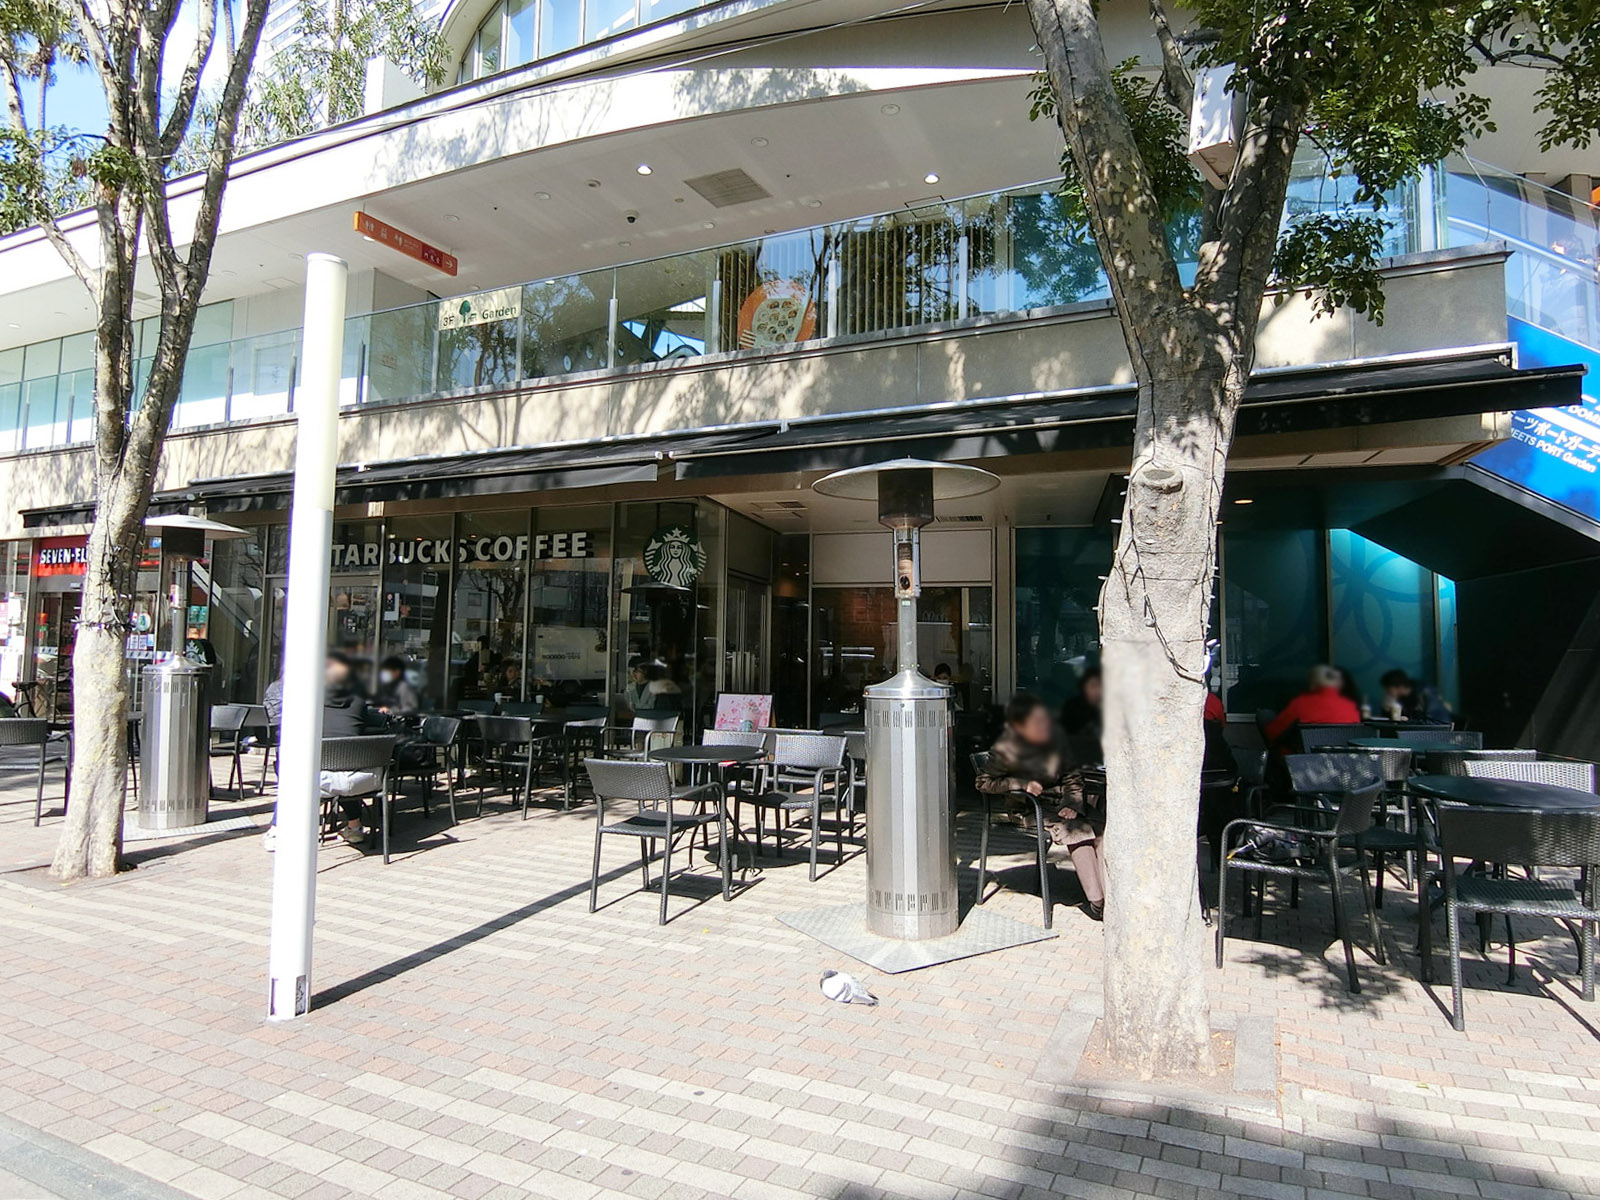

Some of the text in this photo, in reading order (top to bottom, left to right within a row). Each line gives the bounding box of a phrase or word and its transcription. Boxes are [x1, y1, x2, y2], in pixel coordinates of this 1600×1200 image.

[443, 306, 517, 327] 3F Garden
[1567, 405, 1600, 424] DOM
[1535, 439, 1565, 458] PORT
[1562, 452, 1598, 474] Garden
[40, 547, 88, 564] SEVEN-EL
[332, 532, 588, 566] TARBUCKS COFFEE
